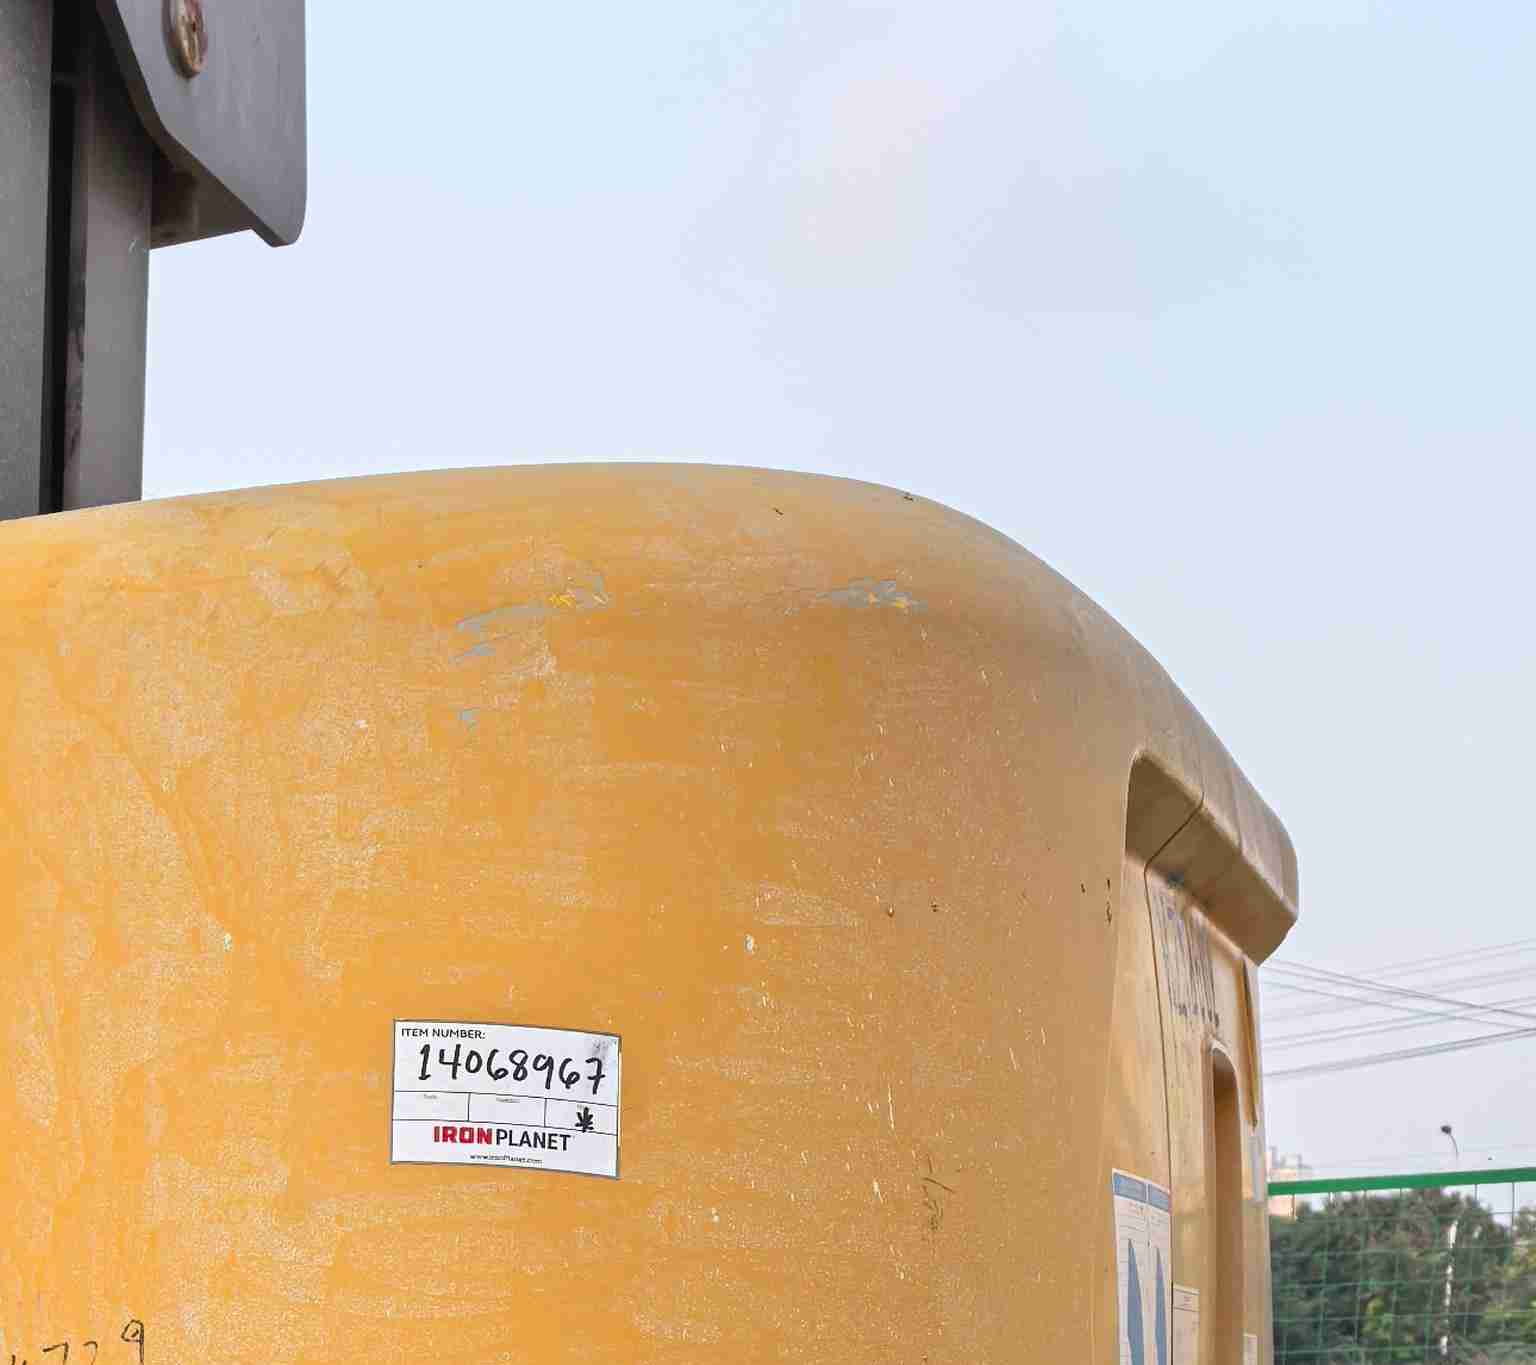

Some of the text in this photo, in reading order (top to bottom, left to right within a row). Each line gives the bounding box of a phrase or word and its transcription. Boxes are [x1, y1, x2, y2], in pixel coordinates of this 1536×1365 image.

[401, 1027, 486, 1040] ITEM NUMBER:
[418, 1043, 606, 1094] 14068967
